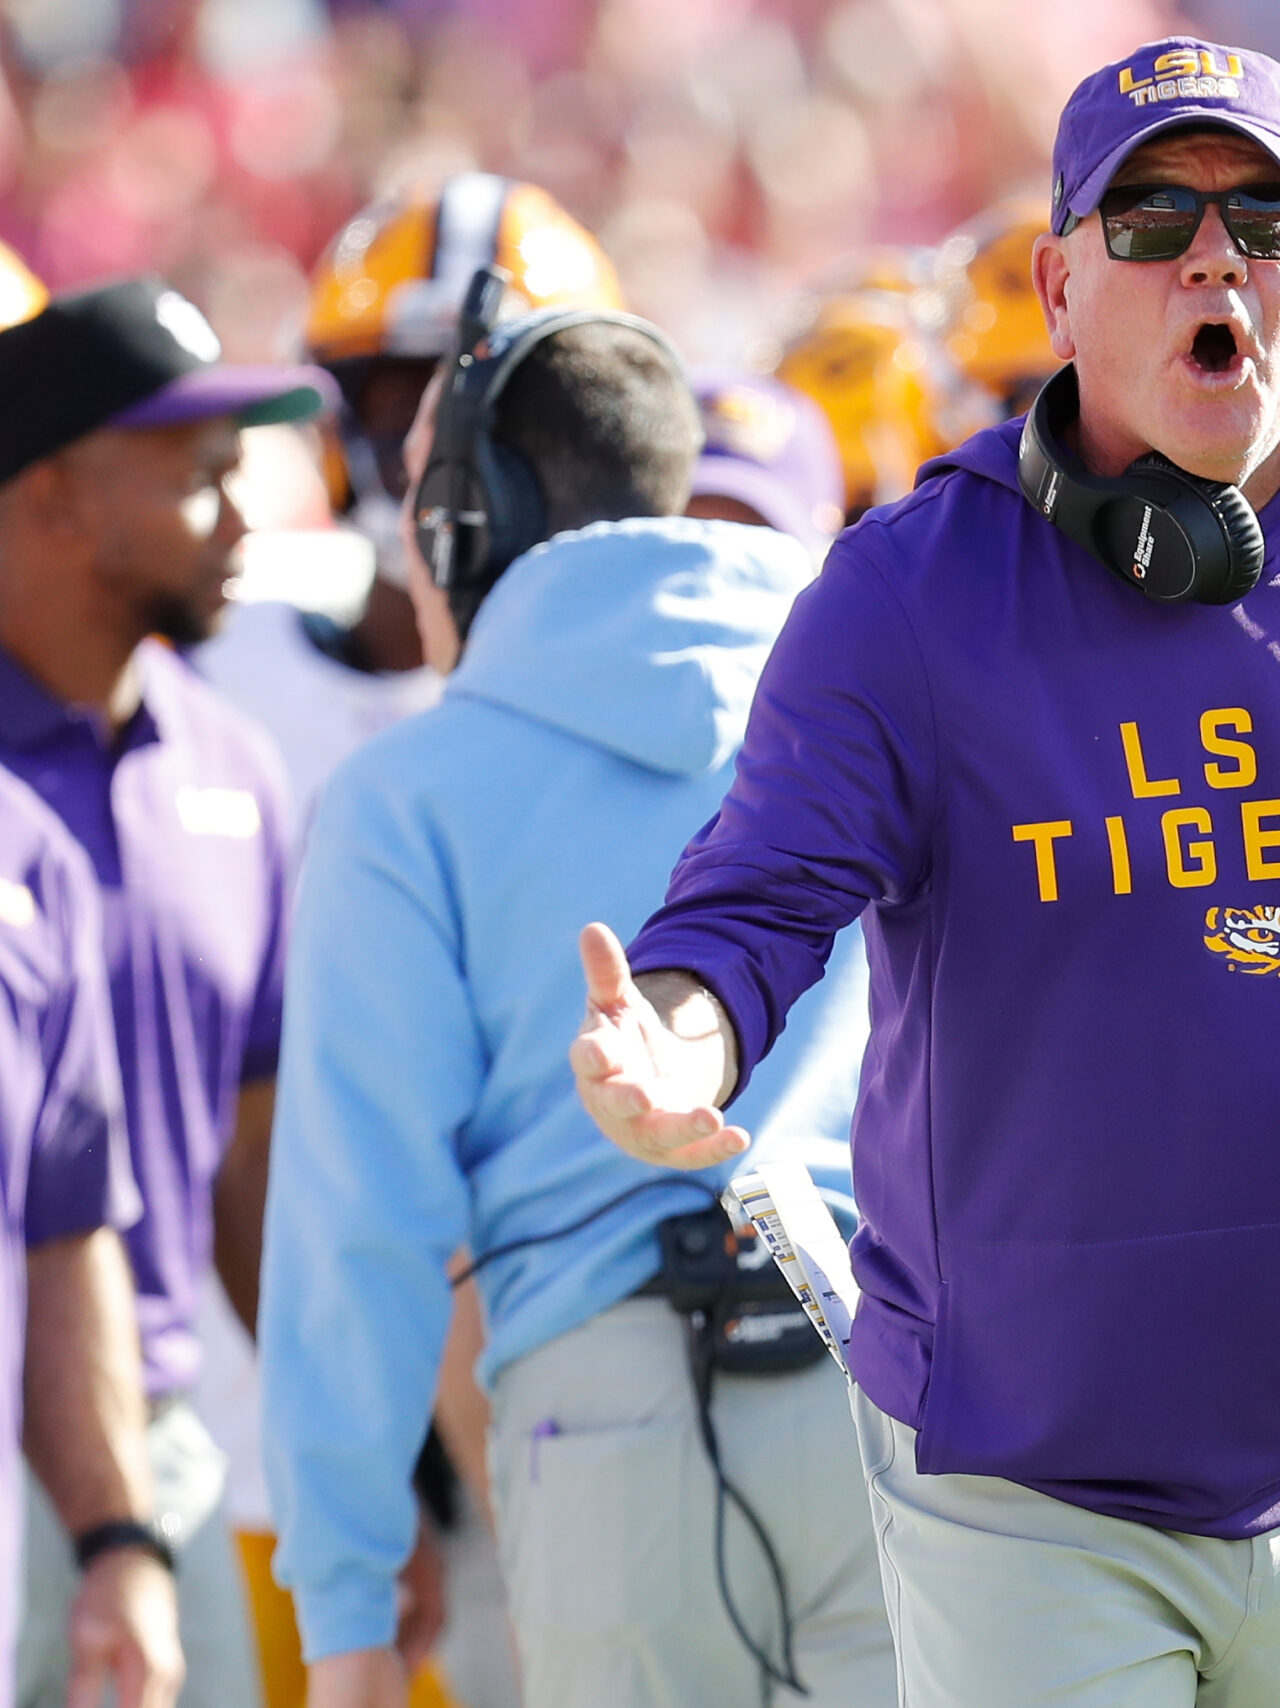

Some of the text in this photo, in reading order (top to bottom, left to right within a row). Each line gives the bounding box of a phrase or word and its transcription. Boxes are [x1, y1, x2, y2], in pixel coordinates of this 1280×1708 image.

[1118, 49, 1245, 94] LSU
[1128, 76, 1241, 107] TIGERS
[1133, 505, 1152, 562] Equipment
[1141, 535, 1155, 568] Share
